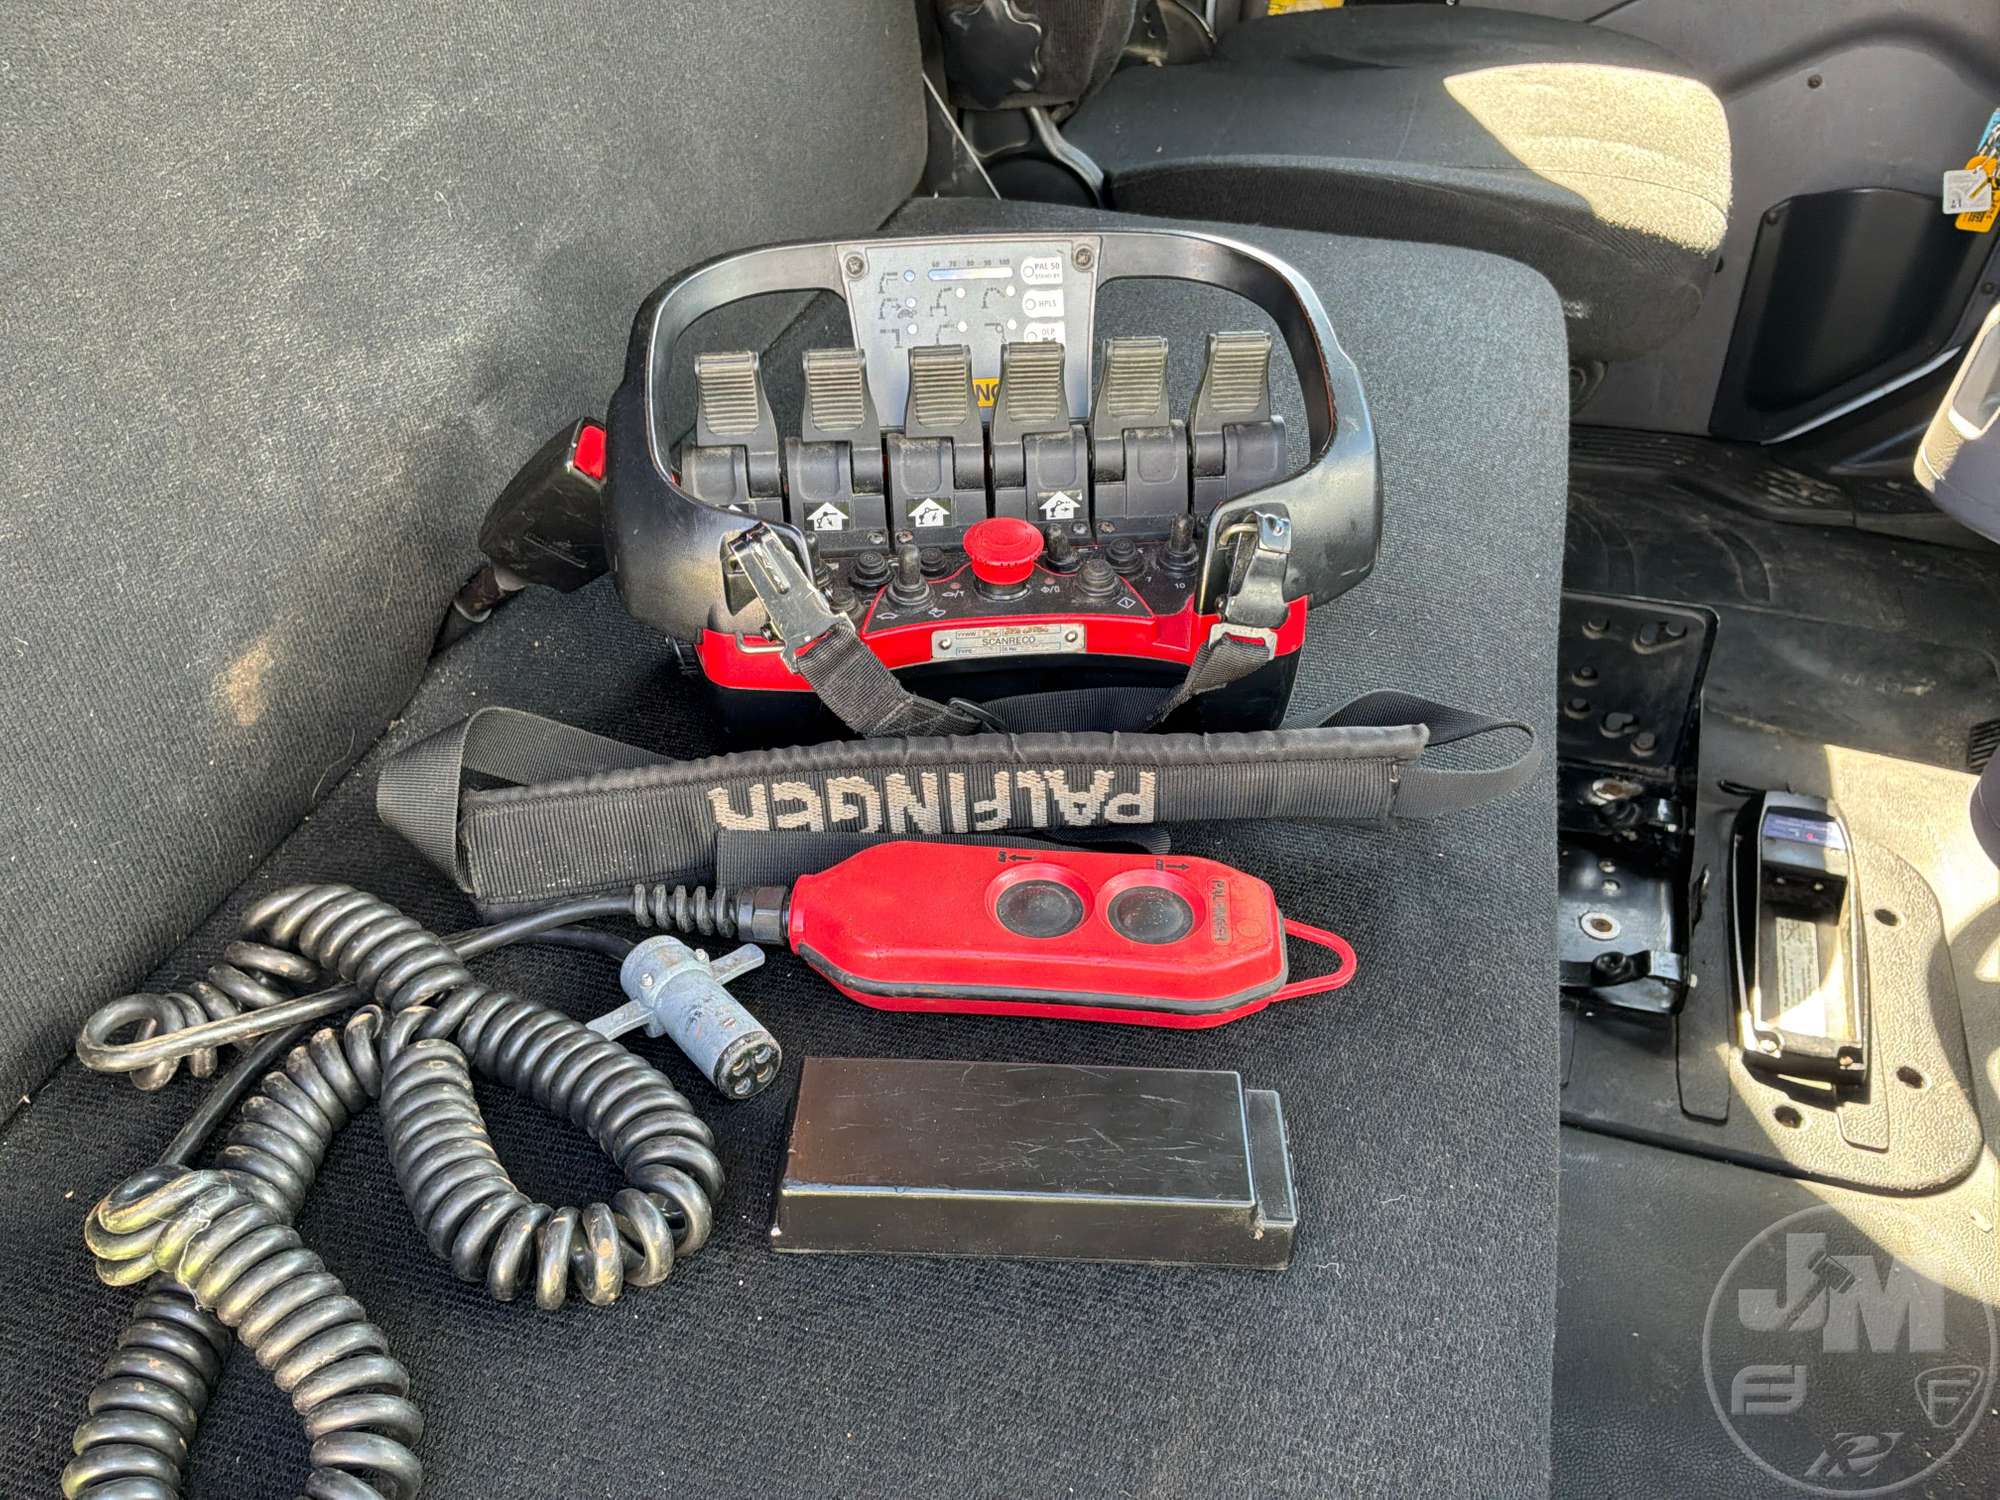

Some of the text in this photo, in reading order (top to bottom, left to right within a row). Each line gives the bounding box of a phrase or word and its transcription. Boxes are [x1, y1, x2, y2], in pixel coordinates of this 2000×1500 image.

[1034, 263, 1049, 271] PAL
[982, 636, 1036, 647] SCANRECO
[707, 769, 1156, 833] PALFINGER
